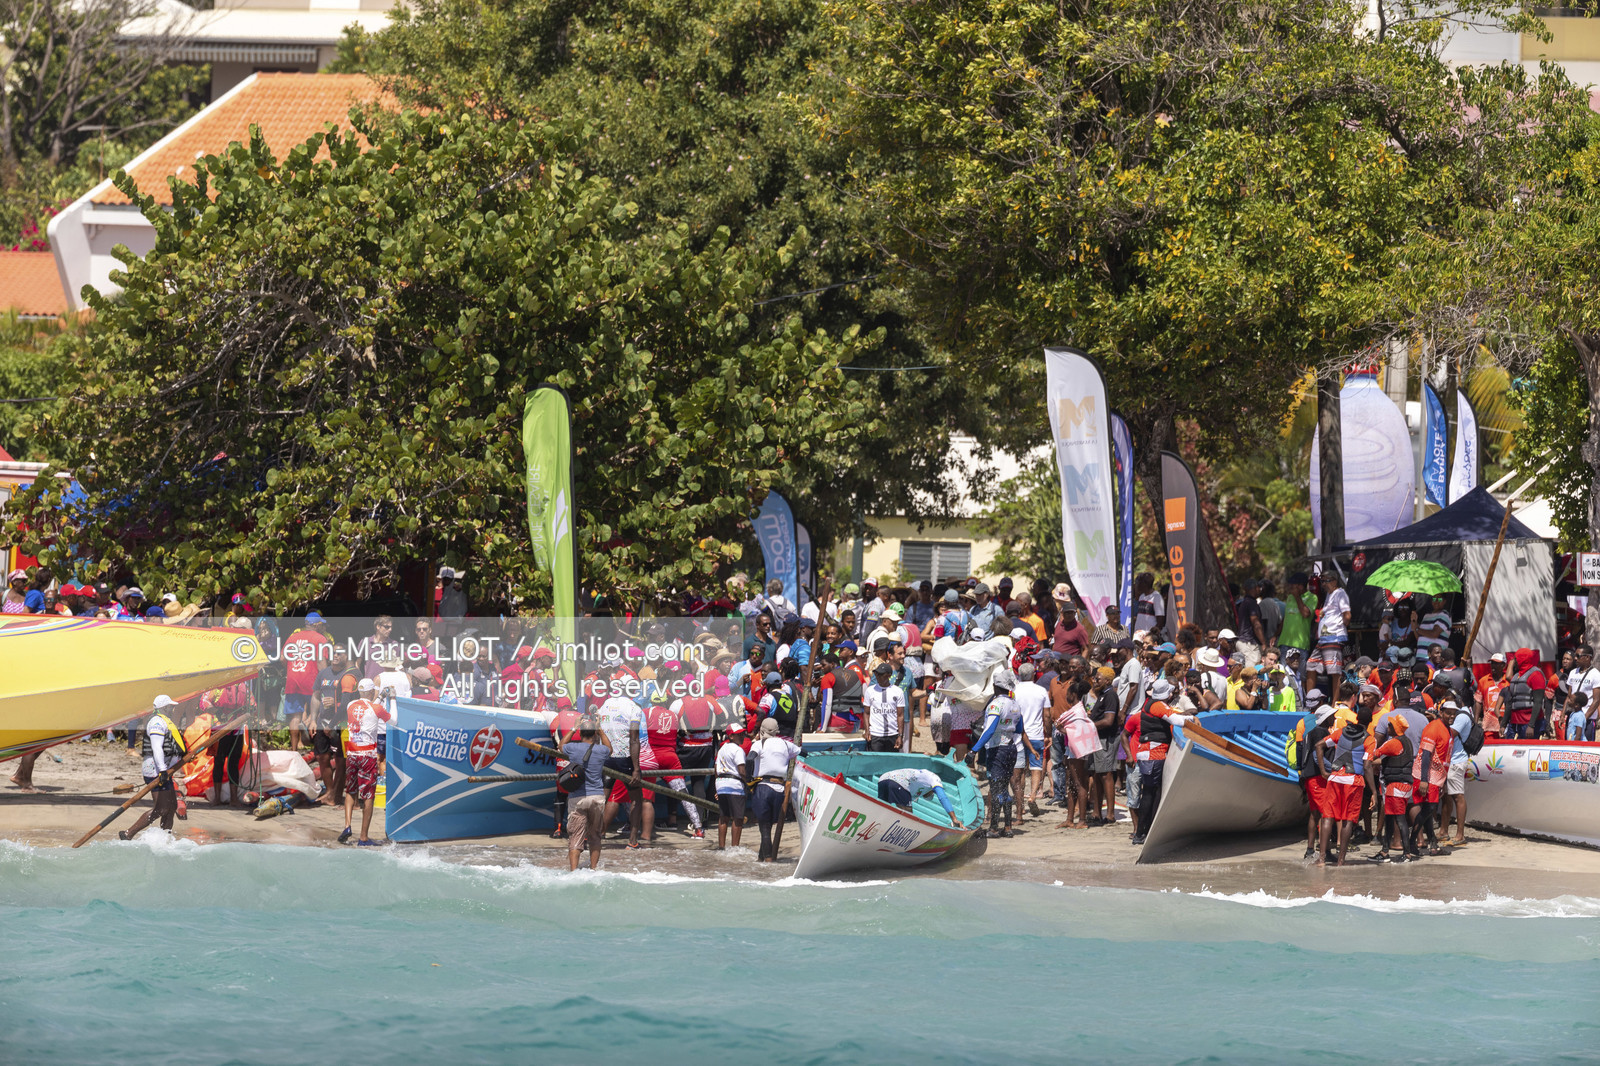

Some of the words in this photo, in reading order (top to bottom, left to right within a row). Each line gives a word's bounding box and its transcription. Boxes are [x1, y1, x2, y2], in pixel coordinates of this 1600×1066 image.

[1582, 570, 1596, 580] NON
[414, 720, 469, 745] Brasserie
[404, 733, 467, 762] Lorraine
[799, 784, 814, 818] UFR
[827, 806, 867, 838] UFR
